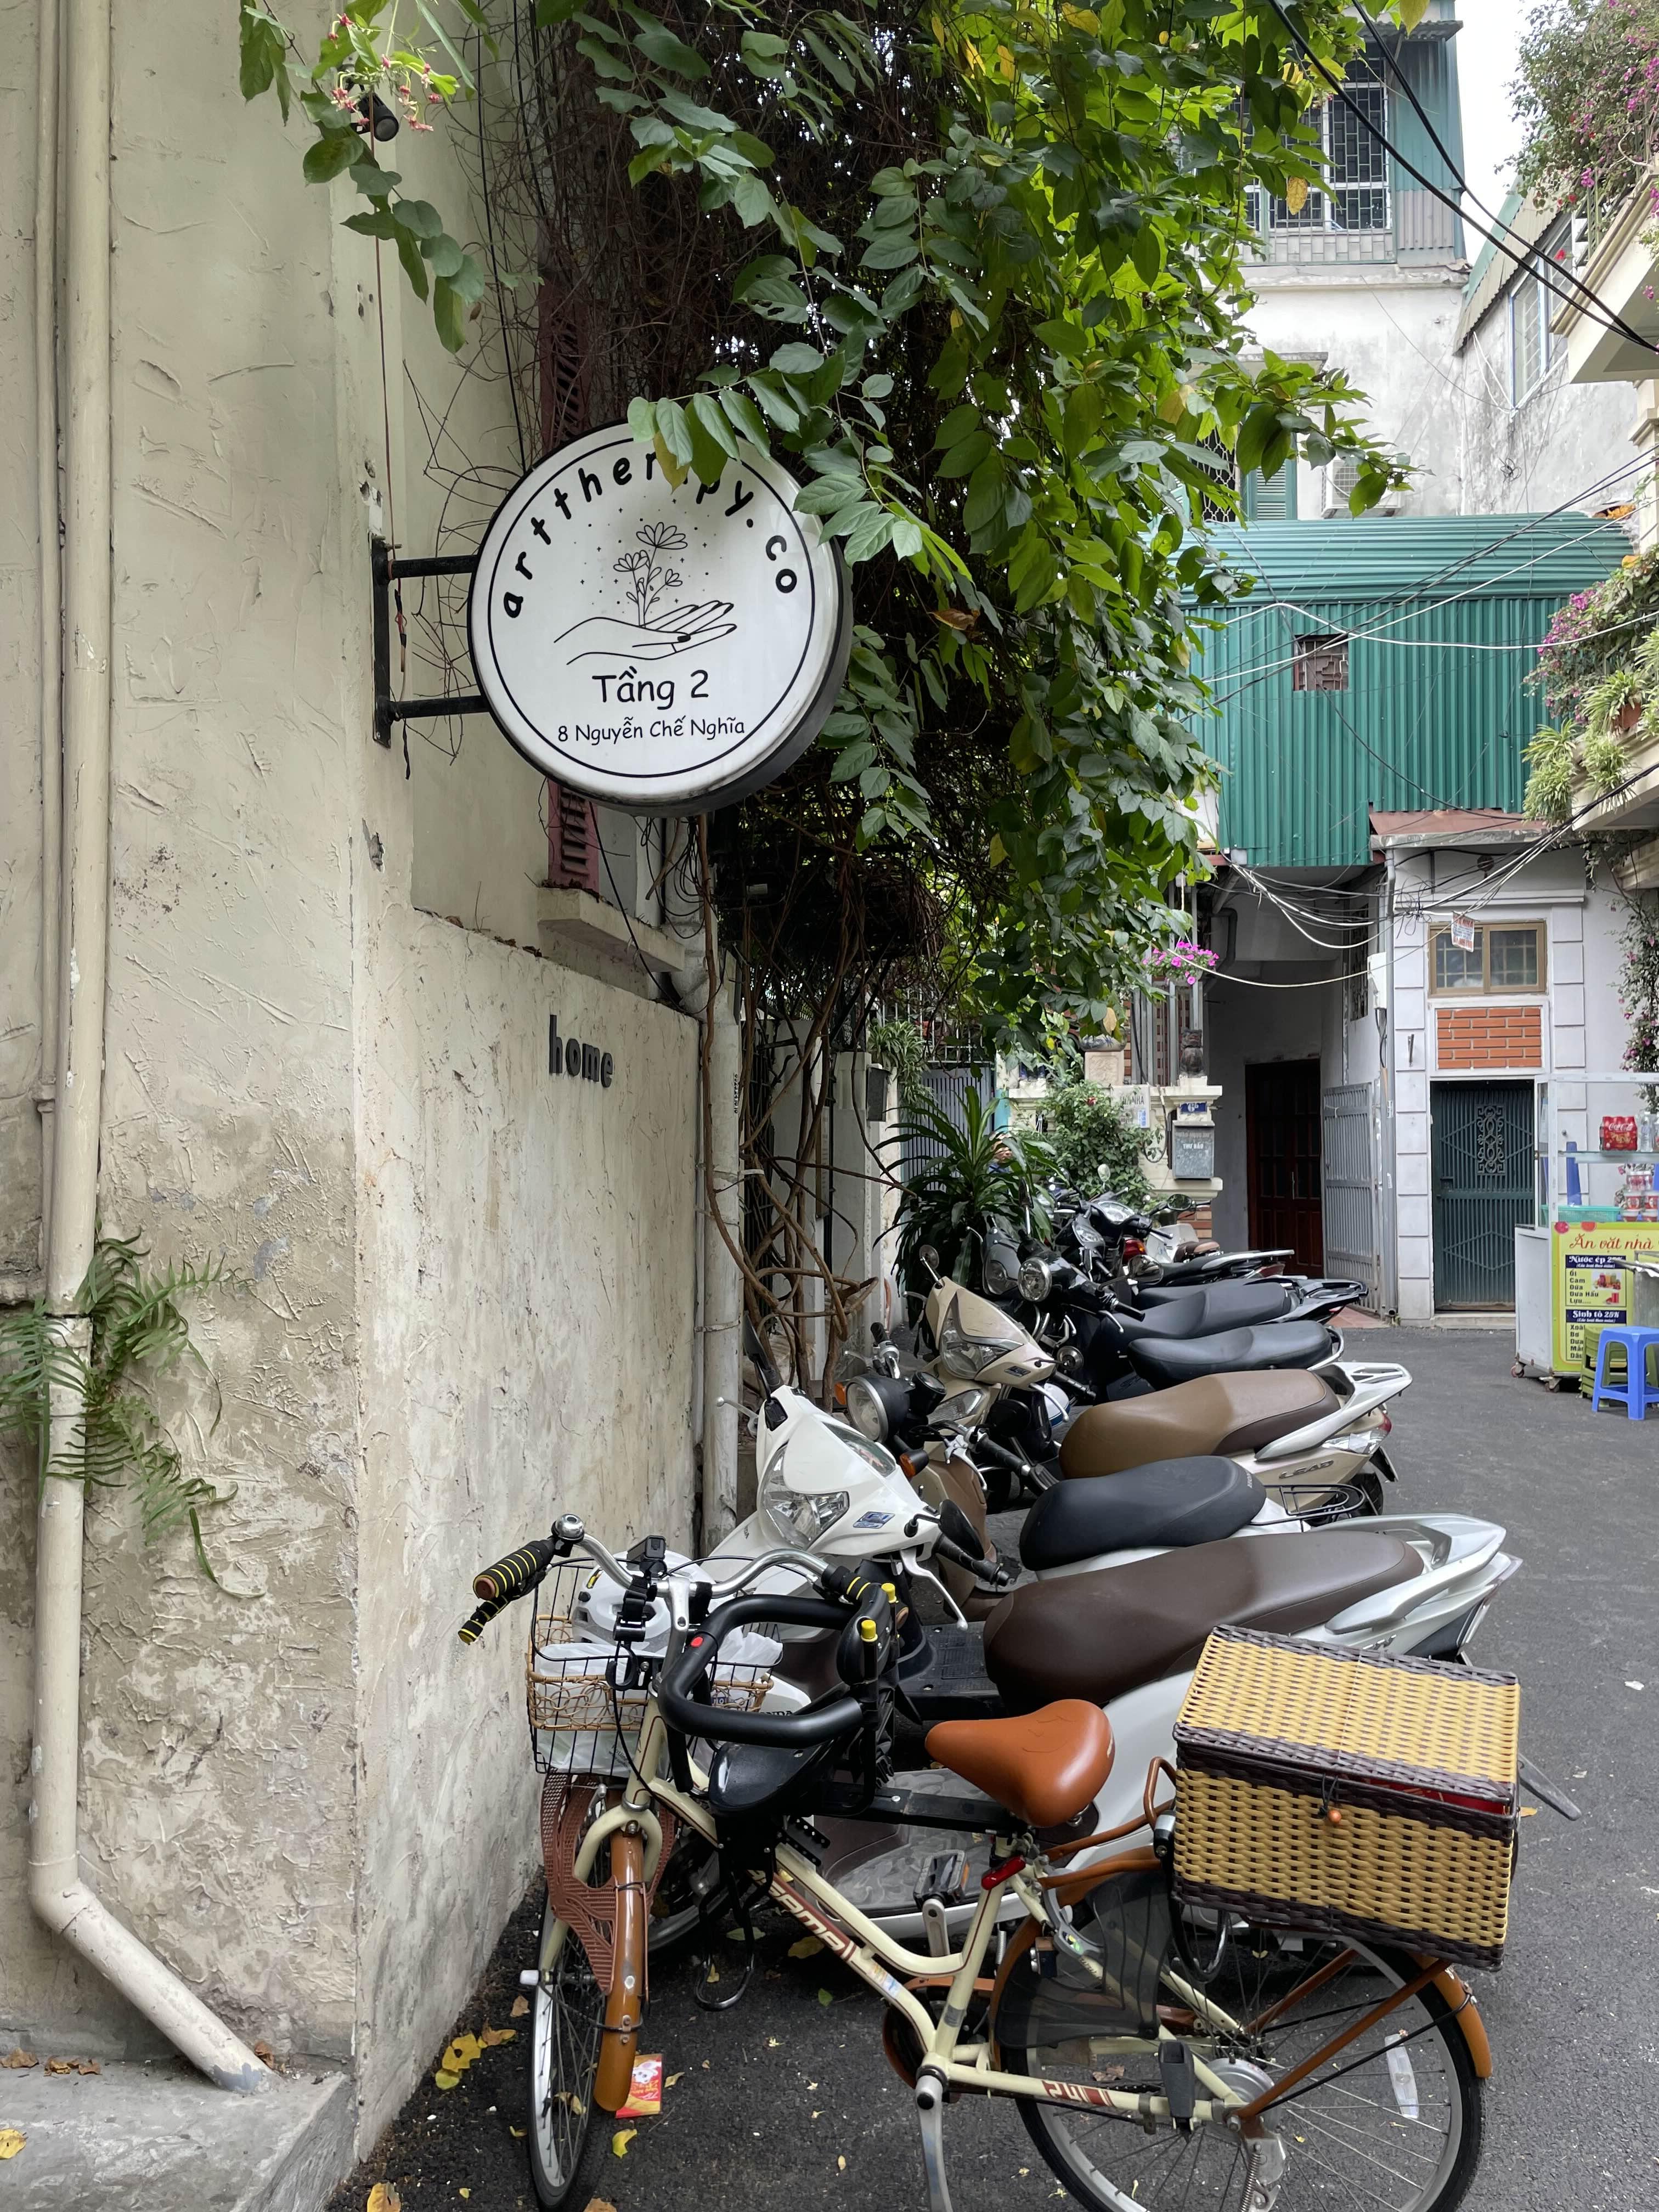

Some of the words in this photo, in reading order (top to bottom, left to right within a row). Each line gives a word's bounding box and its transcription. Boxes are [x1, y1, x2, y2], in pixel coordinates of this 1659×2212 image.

[504, 452, 797, 619] arttherpy.co
[592, 666, 675, 710] Tầng
[691, 670, 709, 699] 2
[557, 726, 568, 742] 8
[576, 716, 643, 745] Nguyễn
[650, 715, 686, 738] Chế
[691, 716, 744, 742] Nghĩa
[549, 1014, 613, 1088] home
[1570, 1233, 1596, 1249] Ăn
[1599, 1237, 1622, 1253] vặt
[1624, 1237, 1654, 1250] nhà
[1279, 1460, 1334, 1479] LEAD
